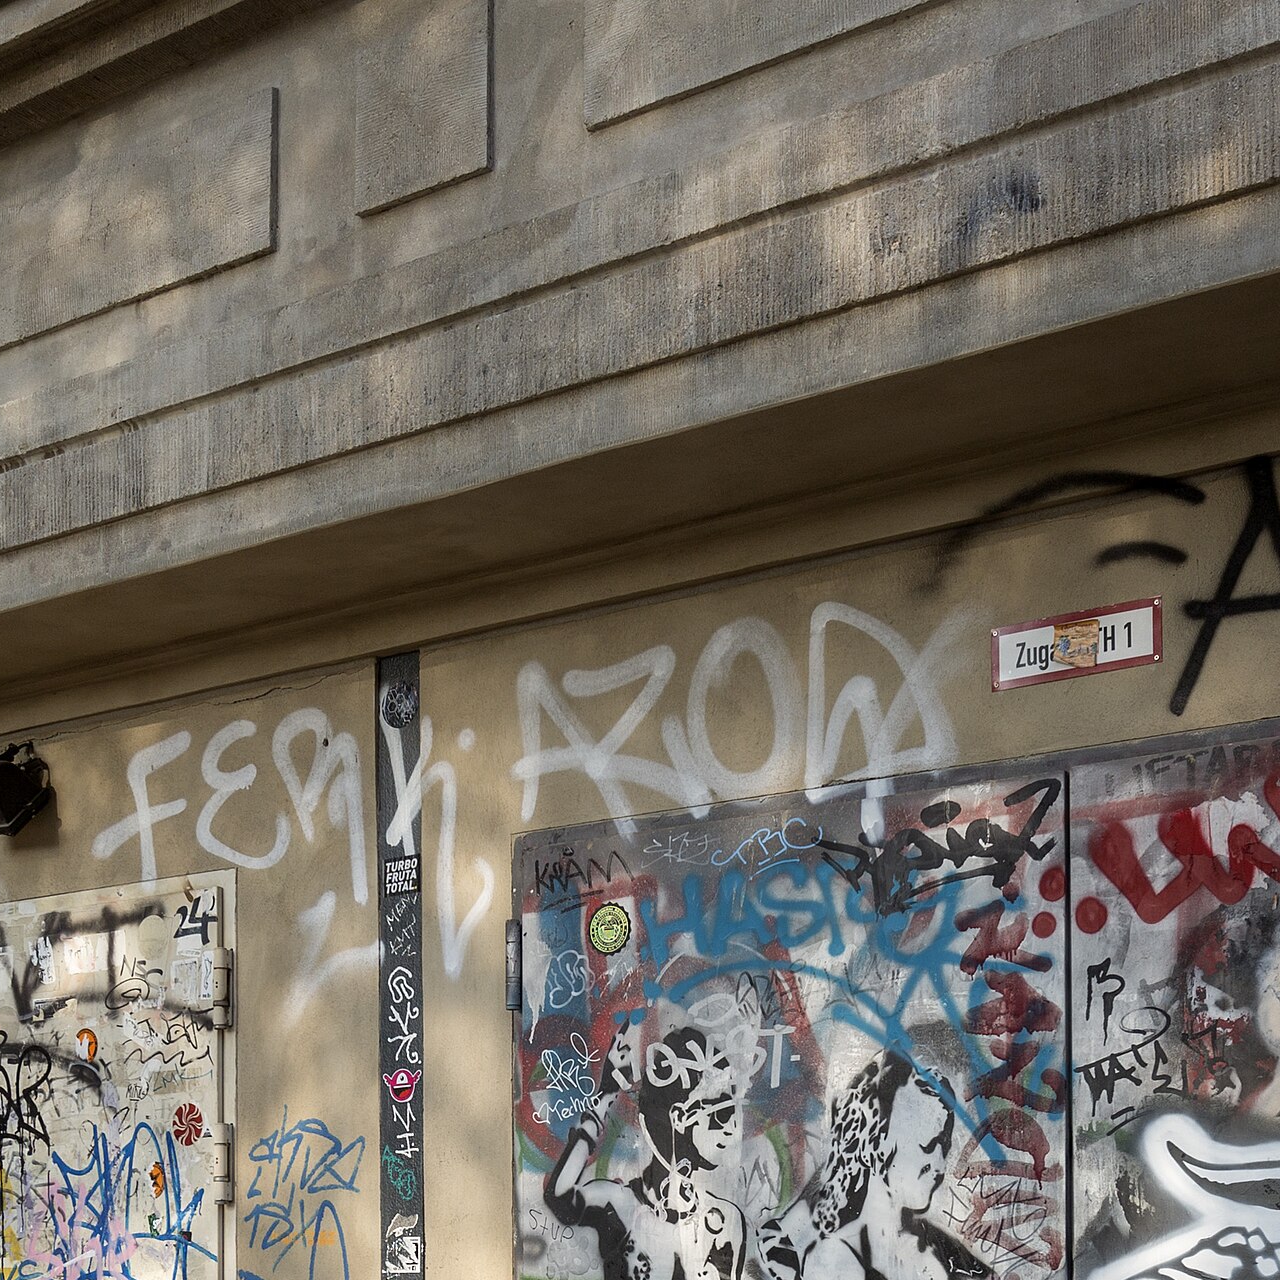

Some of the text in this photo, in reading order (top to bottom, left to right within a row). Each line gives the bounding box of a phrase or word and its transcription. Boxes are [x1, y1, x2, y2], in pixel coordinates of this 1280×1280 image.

[1123, 621, 1133, 649] 1
[385, 858, 418, 873] TURBO
[385, 869, 418, 884] FRUTA
